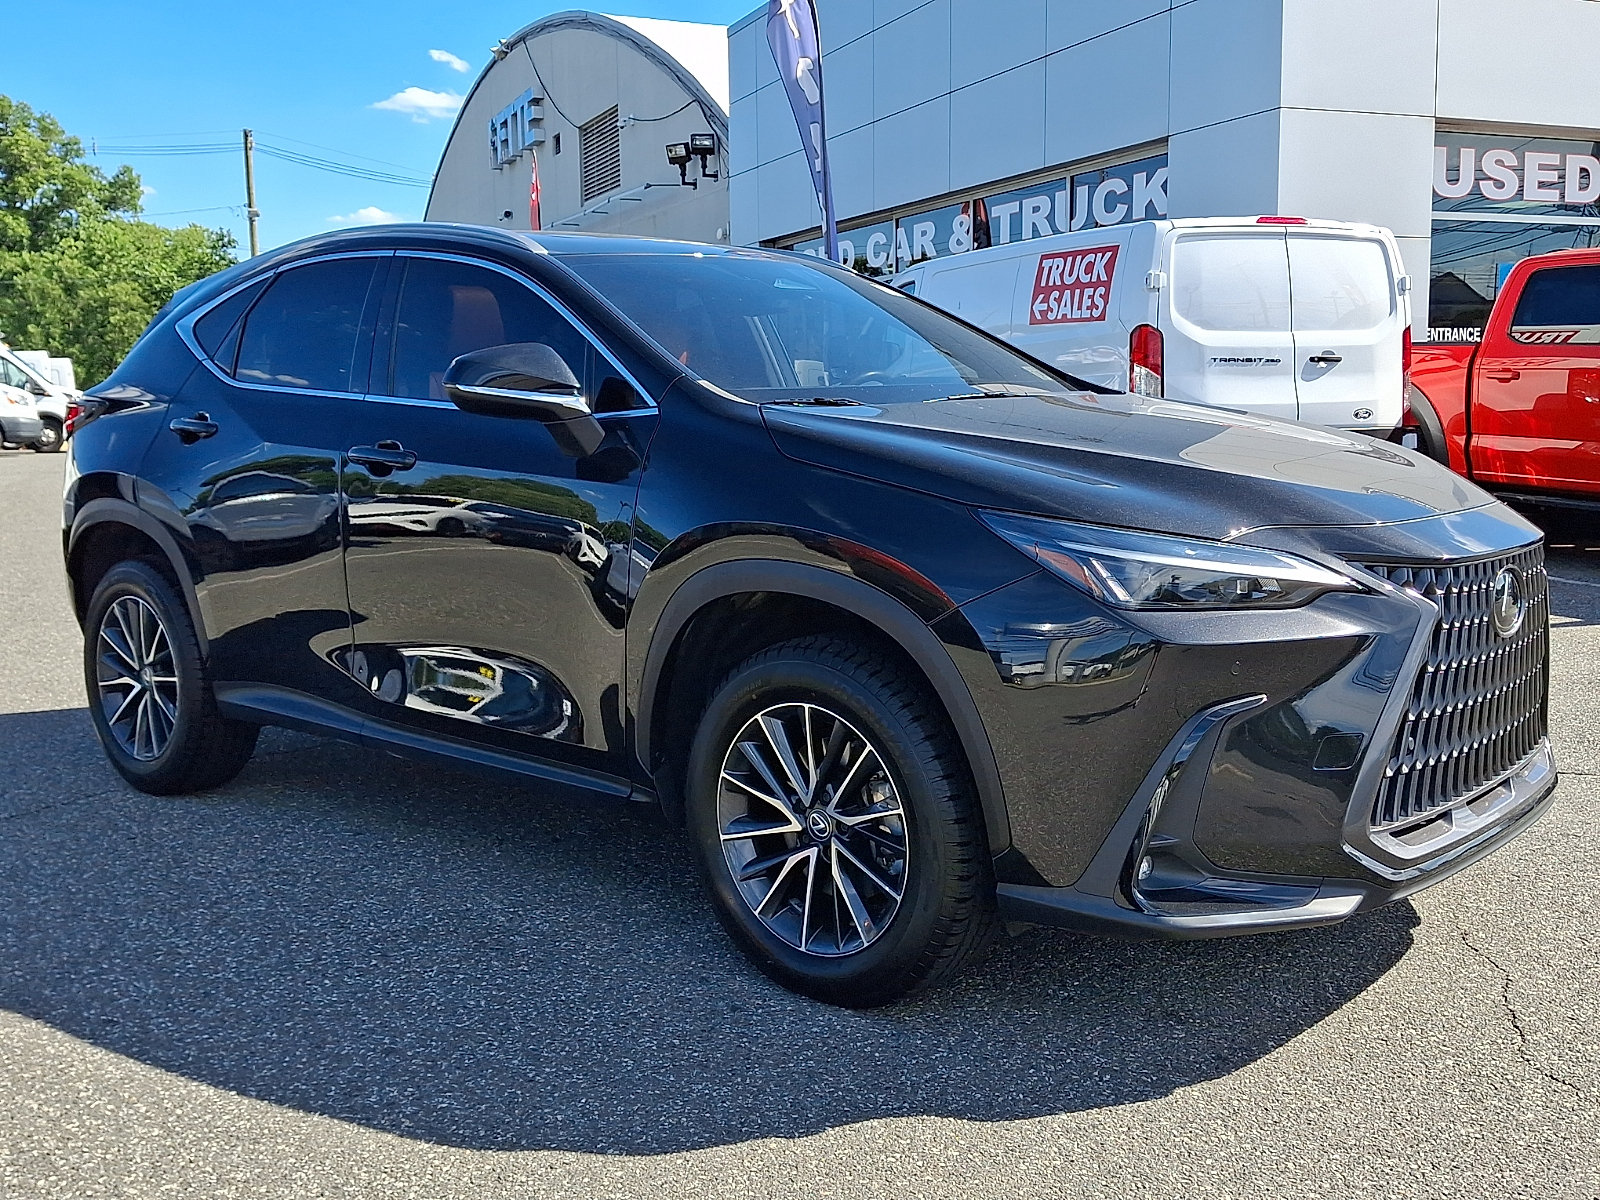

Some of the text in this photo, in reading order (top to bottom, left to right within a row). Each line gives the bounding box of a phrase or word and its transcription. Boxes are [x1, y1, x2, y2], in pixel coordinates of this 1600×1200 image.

[1434, 146, 1600, 204] USED
[866, 221, 937, 268] CAR
[948, 214, 973, 254] &
[991, 167, 1168, 245] TRUCK
[1040, 252, 1113, 287] TRUCK
[1046, 286, 1106, 320] SALES
[1427, 327, 1481, 342] ENTRANCE
